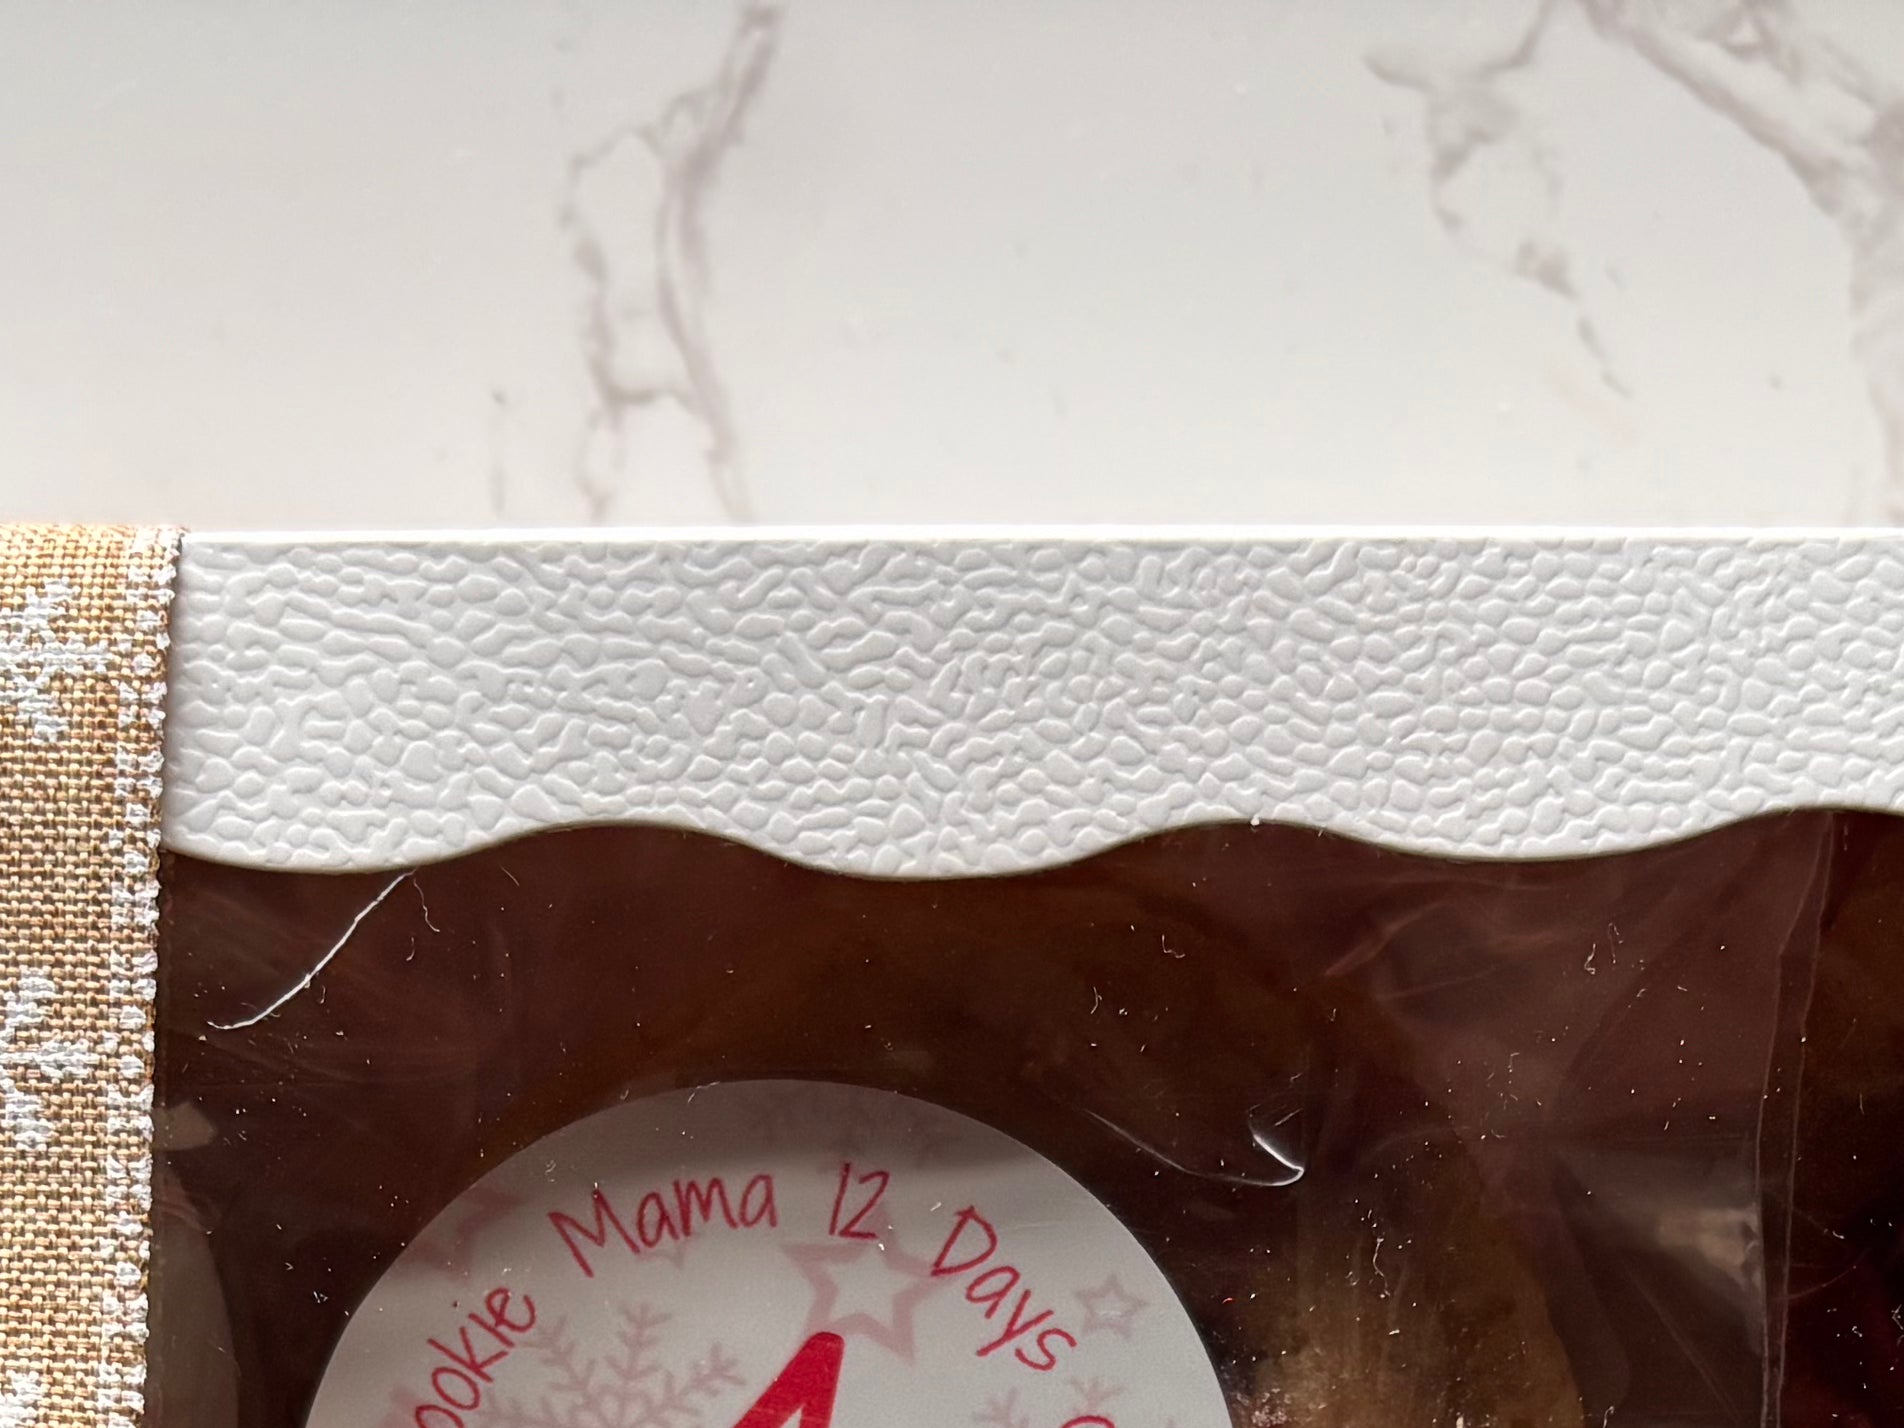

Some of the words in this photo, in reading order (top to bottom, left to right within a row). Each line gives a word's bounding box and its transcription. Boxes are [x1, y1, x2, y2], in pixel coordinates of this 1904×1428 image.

[548, 1172, 777, 1278] Mama
[829, 1162, 890, 1239] 12
[930, 1205, 1078, 1373] Days
